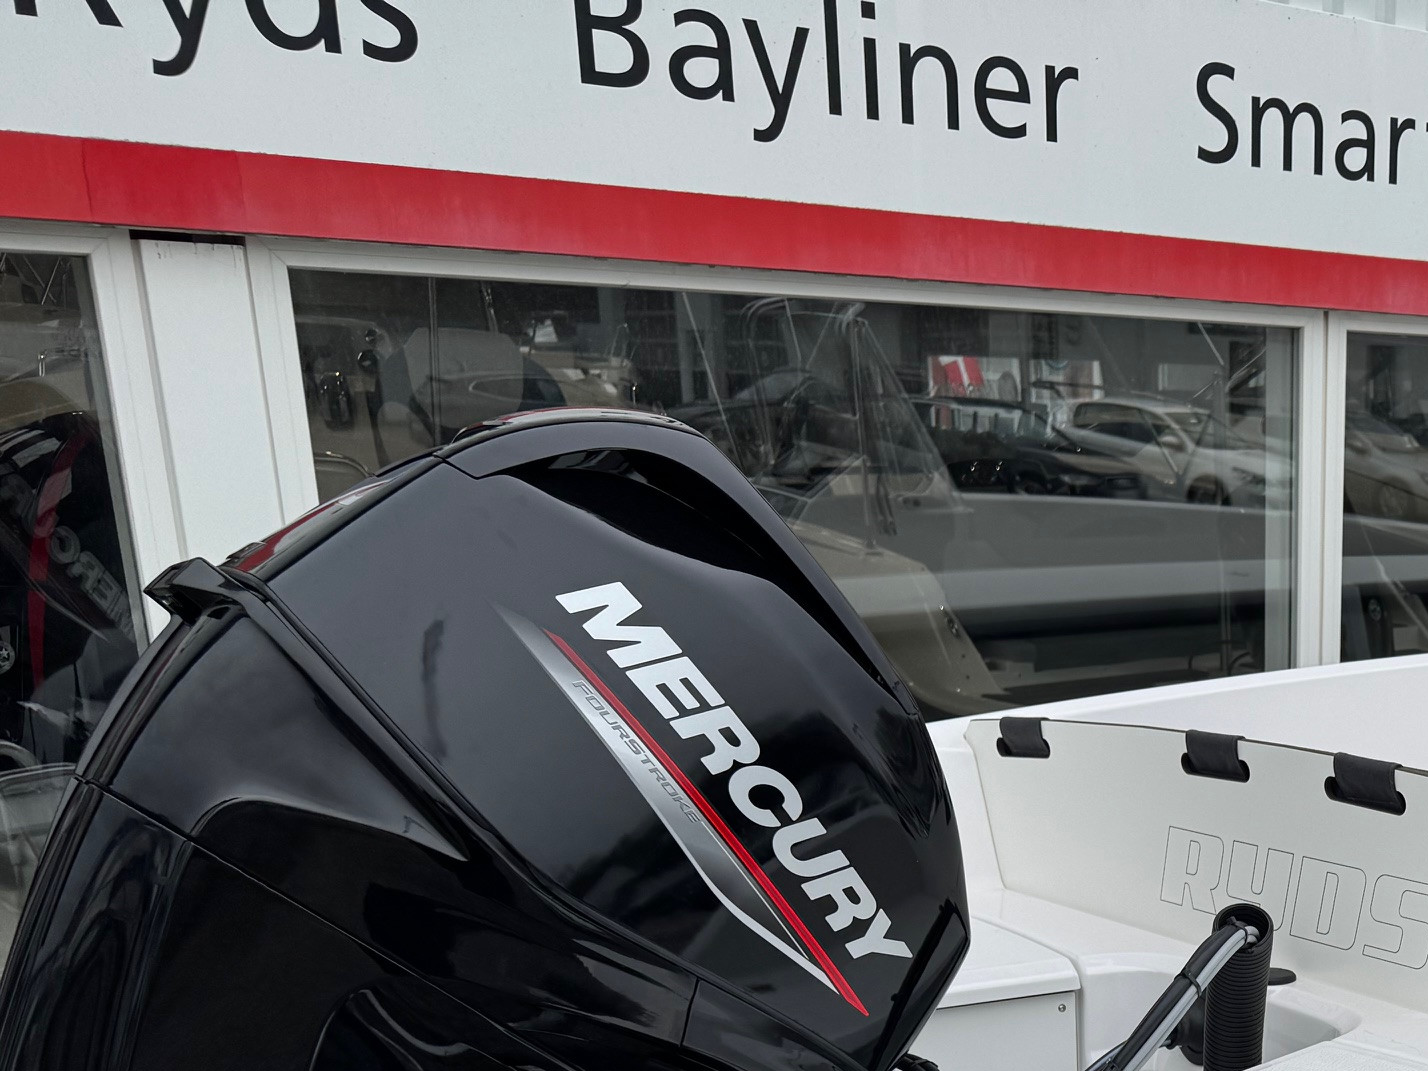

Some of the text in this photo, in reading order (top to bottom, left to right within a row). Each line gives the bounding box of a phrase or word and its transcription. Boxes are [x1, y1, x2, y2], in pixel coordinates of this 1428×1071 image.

[573, 0, 1079, 143] Bayliner
[555, 581, 914, 960] MERCURY
[571, 679, 701, 824] FOURSTROKE
